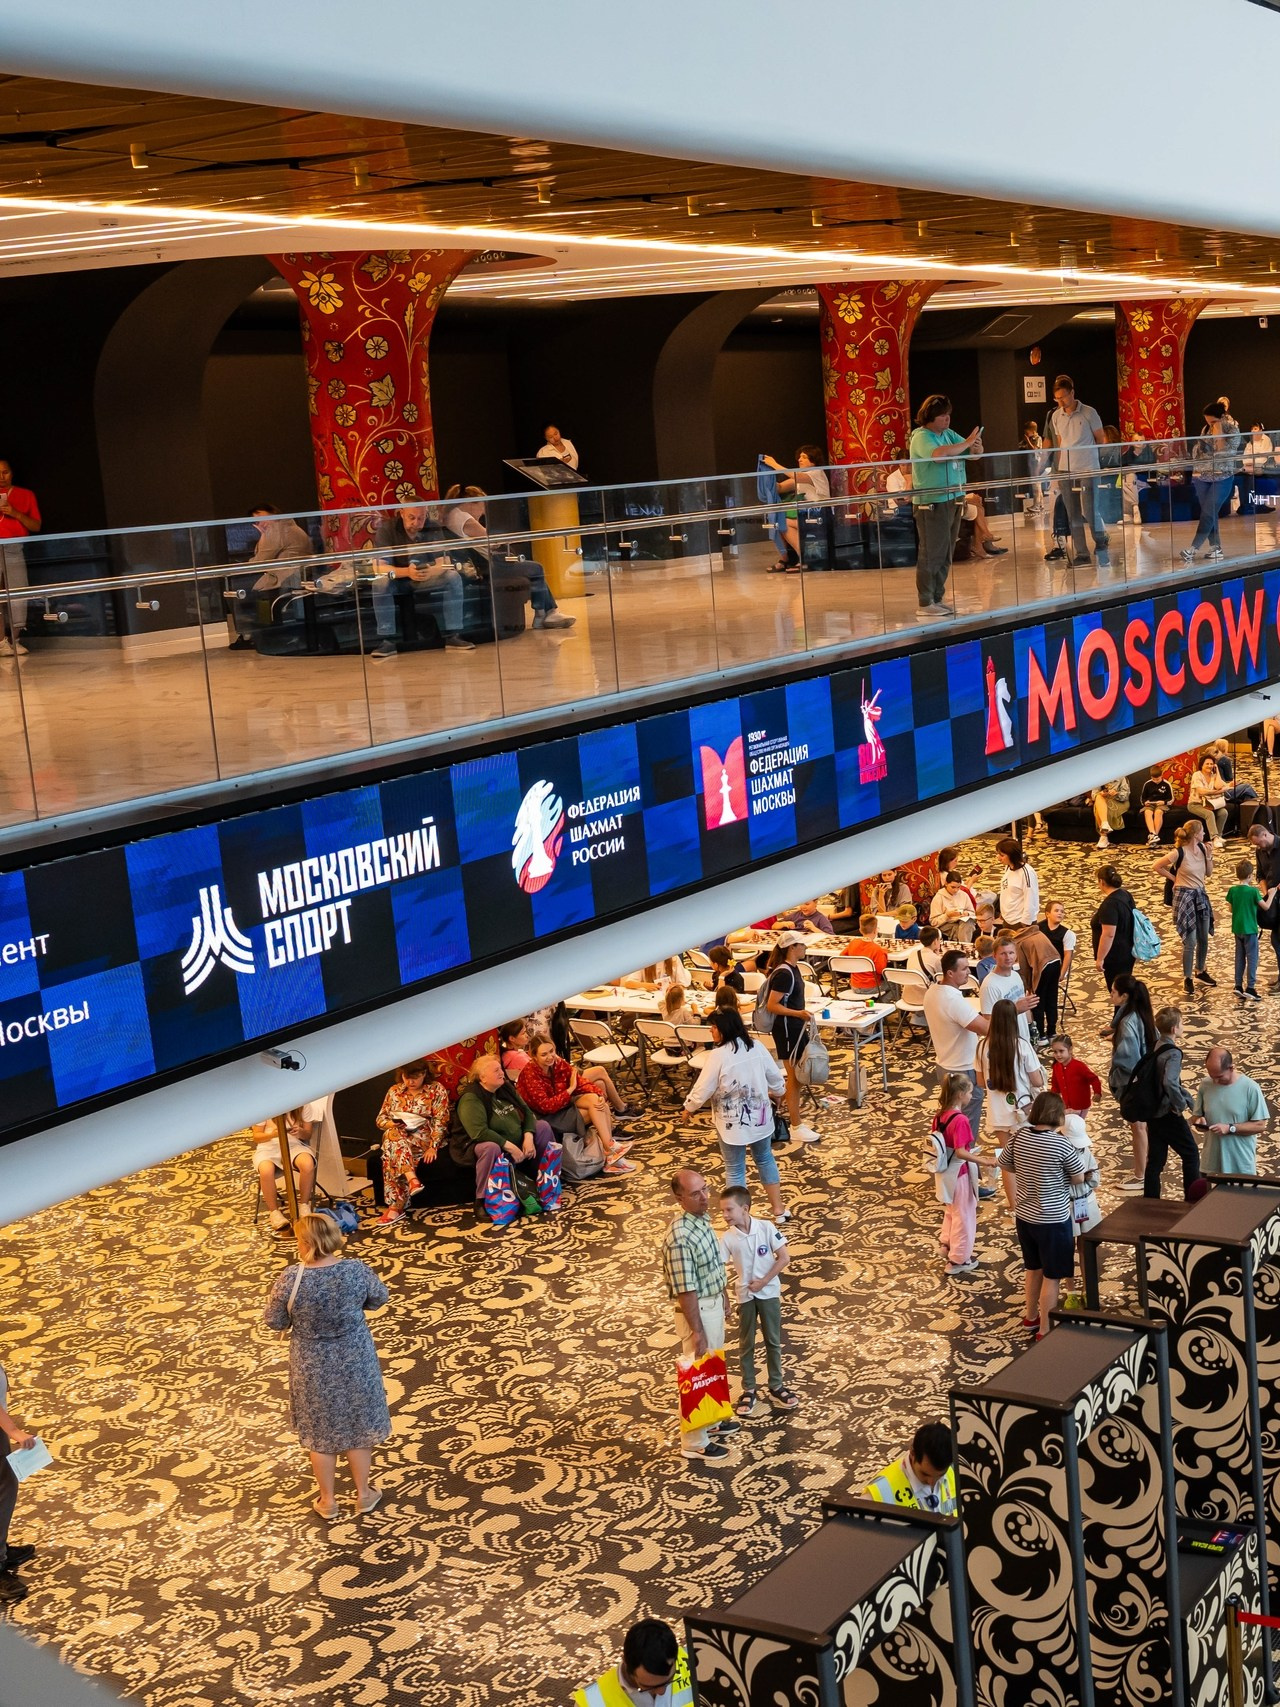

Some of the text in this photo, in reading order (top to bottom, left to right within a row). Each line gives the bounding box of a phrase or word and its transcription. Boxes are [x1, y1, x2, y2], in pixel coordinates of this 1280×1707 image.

[1027, 588, 1265, 744] MOSCOW
[749, 743, 809, 775] ФЕДЕРАЦИЯ
[751, 768, 794, 796] ШАХМАТ
[567, 785, 641, 820] ФЕДЕРАЦИЯ
[752, 787, 797, 816] МОСКВЫ
[569, 813, 624, 844] ШАХМАТ
[571, 835, 626, 866] РОССИИ
[257, 815, 441, 919] МОСКОВСКИЙ
[0, 933, 50, 966] ент
[263, 898, 353, 969] СПОРТ
